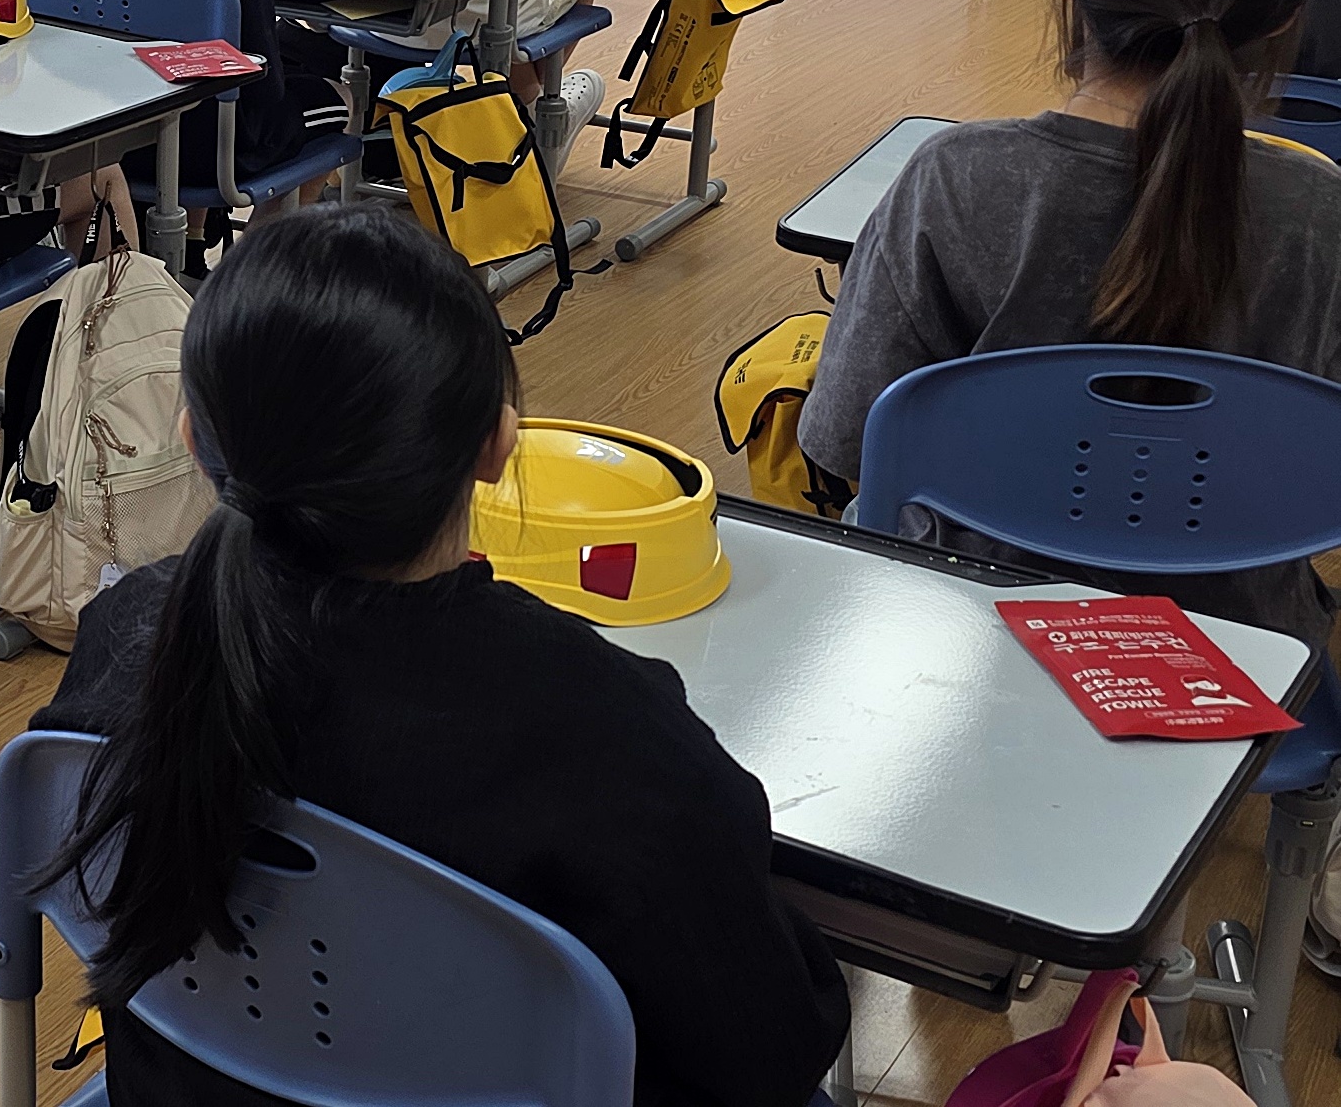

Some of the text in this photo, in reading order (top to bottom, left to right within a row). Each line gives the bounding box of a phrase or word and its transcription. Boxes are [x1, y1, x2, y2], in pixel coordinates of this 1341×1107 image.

[1072, 668, 1115, 682] FIRE
[1082, 677, 1154, 692] ESCAPE
[1091, 688, 1166, 703] RESCUE
[1100, 699, 1168, 713] TOWEL
